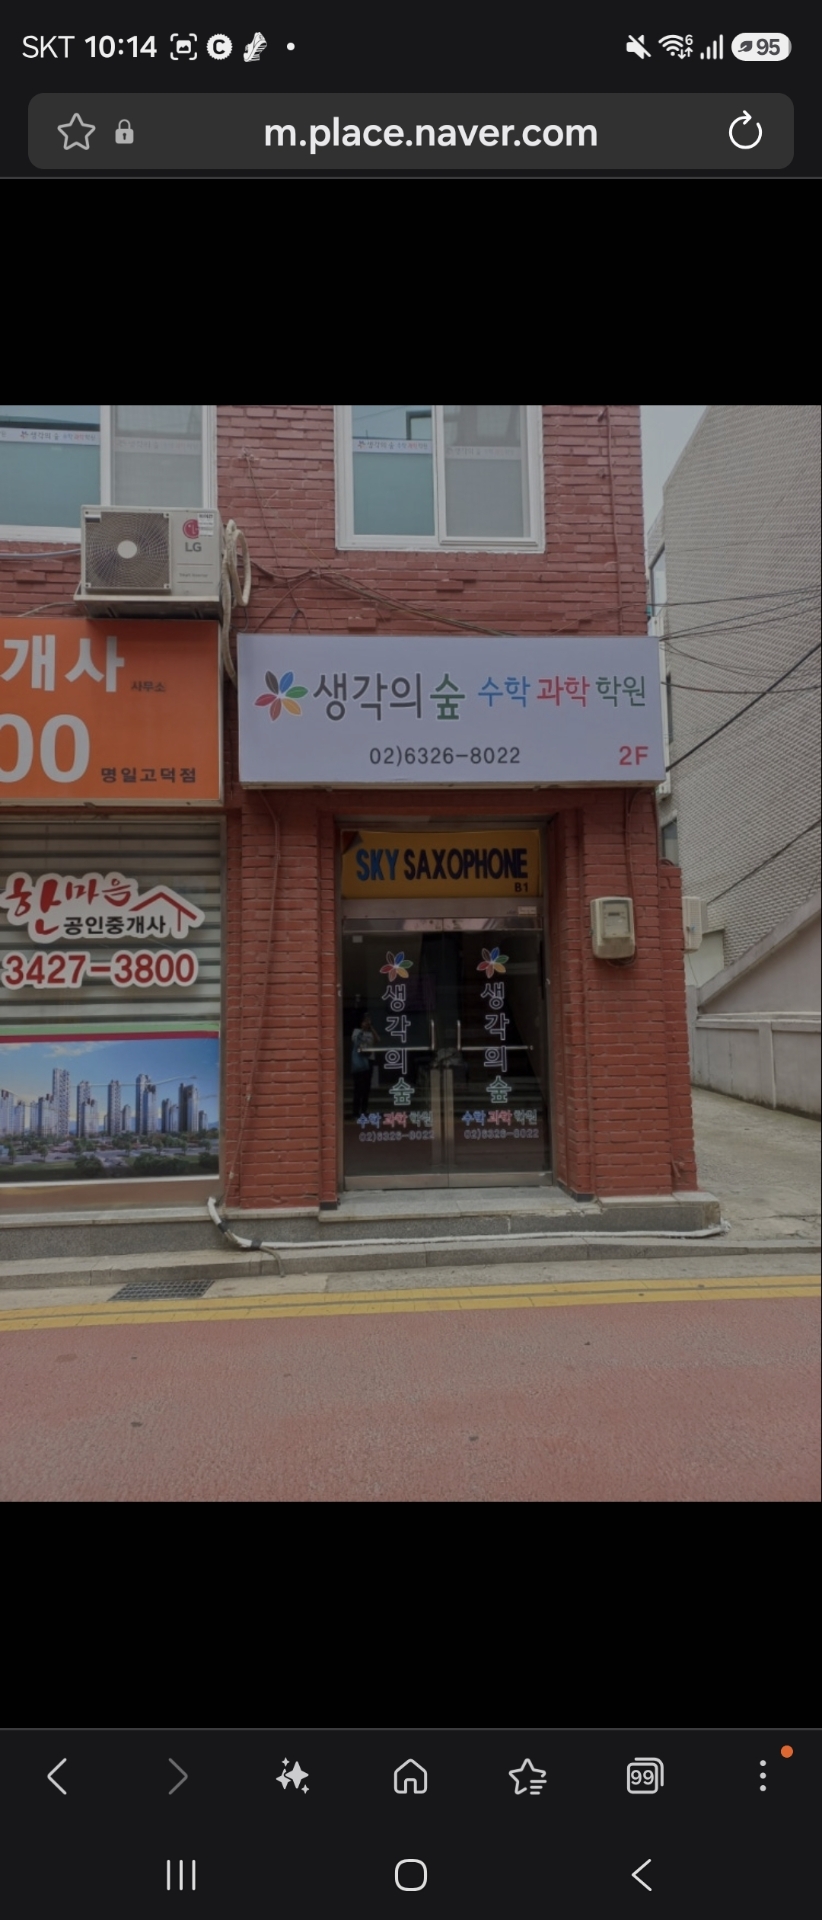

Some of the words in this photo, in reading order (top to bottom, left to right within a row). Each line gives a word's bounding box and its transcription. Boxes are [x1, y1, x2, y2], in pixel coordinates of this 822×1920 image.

[22, 35, 75, 59] SKT
[85, 35, 158, 59] 10:14
[757, 38, 781, 55] 95
[265, 117, 598, 153] m.place.naver.com
[185, 541, 202, 553] LG
[0, 634, 125, 693] 개사
[131, 681, 166, 692] 사무소
[478, 675, 531, 708] 수학
[536, 675, 590, 708] 과학
[596, 675, 645, 707] 학원
[0, 713, 90, 783] 00
[369, 746, 521, 767] 02)6326-8022
[619, 746, 649, 766] 2F
[101, 767, 196, 783] 명일고덕점
[356, 849, 398, 881] SKY
[404, 848, 528, 880] SAXOPHONE
[515, 882, 529, 892] B1
[6, 878, 131, 935] 한마음
[63, 916, 166, 934] 공인중개사
[5, 954, 194, 985] 3427-3800
[356, 1113, 381, 1129] 수학
[383, 1112, 408, 1128] 과학
[461, 1111, 486, 1127] 수학
[488, 1110, 512, 1126] 과학
[514, 1109, 537, 1125] 학원
[630, 1770, 654, 1785] 99
